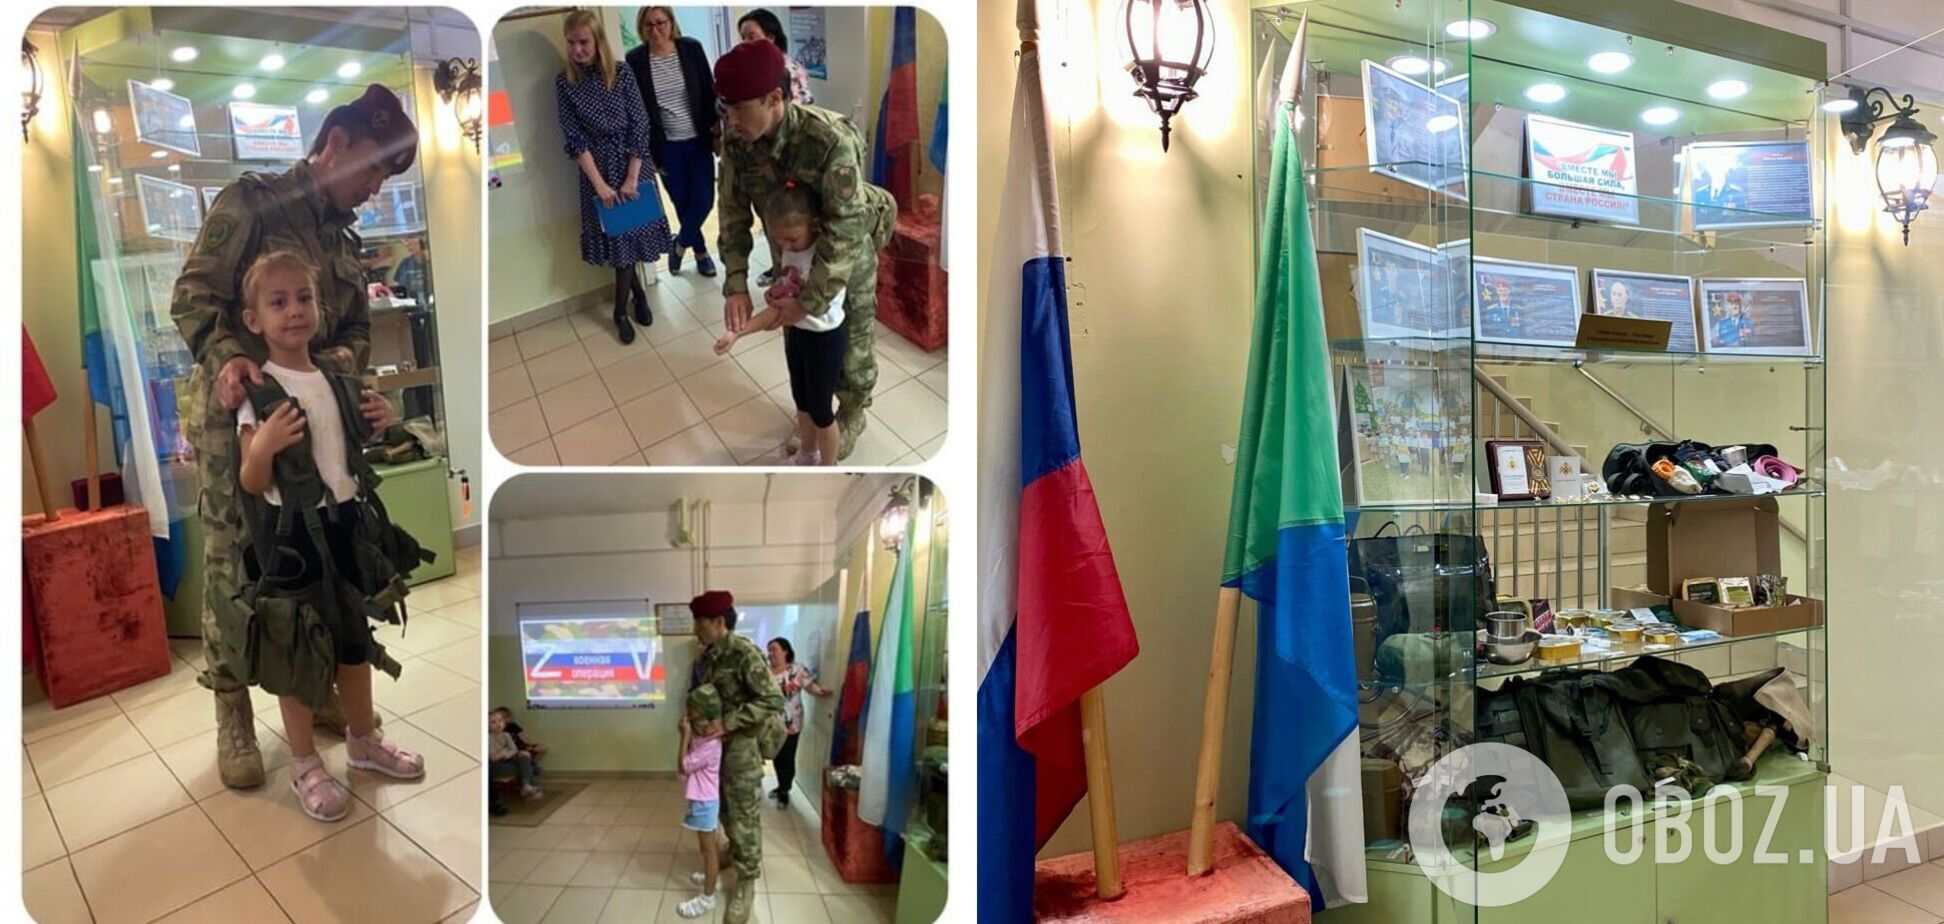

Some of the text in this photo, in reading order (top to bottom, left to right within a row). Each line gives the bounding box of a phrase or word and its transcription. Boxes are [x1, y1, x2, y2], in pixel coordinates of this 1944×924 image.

[1547, 170, 1625, 191] БОЛЬШАЯ СИЛА,
[1545, 191, 1583, 205] СТРАНА
